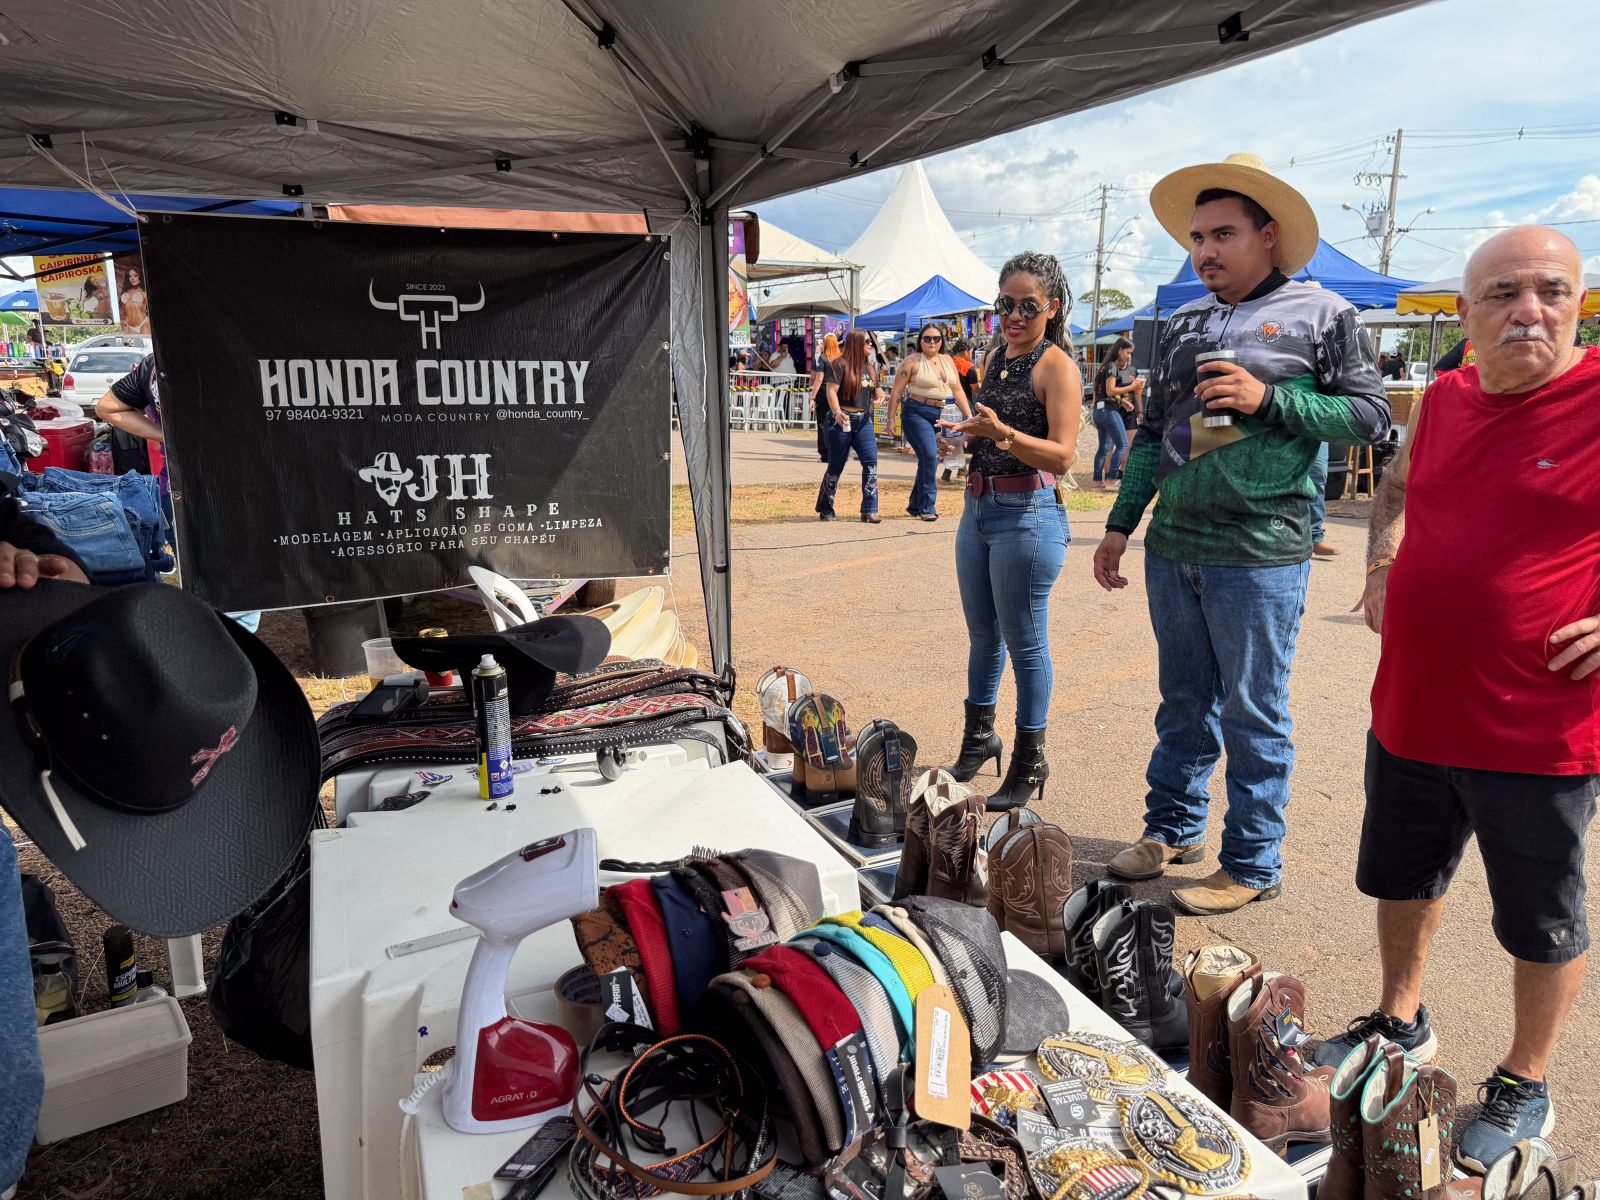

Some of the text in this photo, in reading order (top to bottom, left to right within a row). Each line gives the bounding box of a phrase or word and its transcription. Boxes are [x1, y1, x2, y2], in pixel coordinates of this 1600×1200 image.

[39, 254, 99, 270] CAIPIRINHA
[40, 265, 104, 283] CAIPIROSKA
[406, 283, 446, 291] SINCE 2023
[257, 359, 590, 408] HONDA COUNTRY
[265, 408, 590, 423] 97 98404-9321 MODA COUNTRY @honda_country_
[405, 453, 494, 502] JH
[337, 502, 559, 526] HATS SHAPE
[474, 523, 491, 533] DE
[498, 522, 534, 532] GOMA
[430, 538, 465, 551] PARA
[471, 536, 497, 546] SEU
[504, 533, 556, 544] CHAPÉU
[1052, 1091, 1089, 1106] SUMETAL
